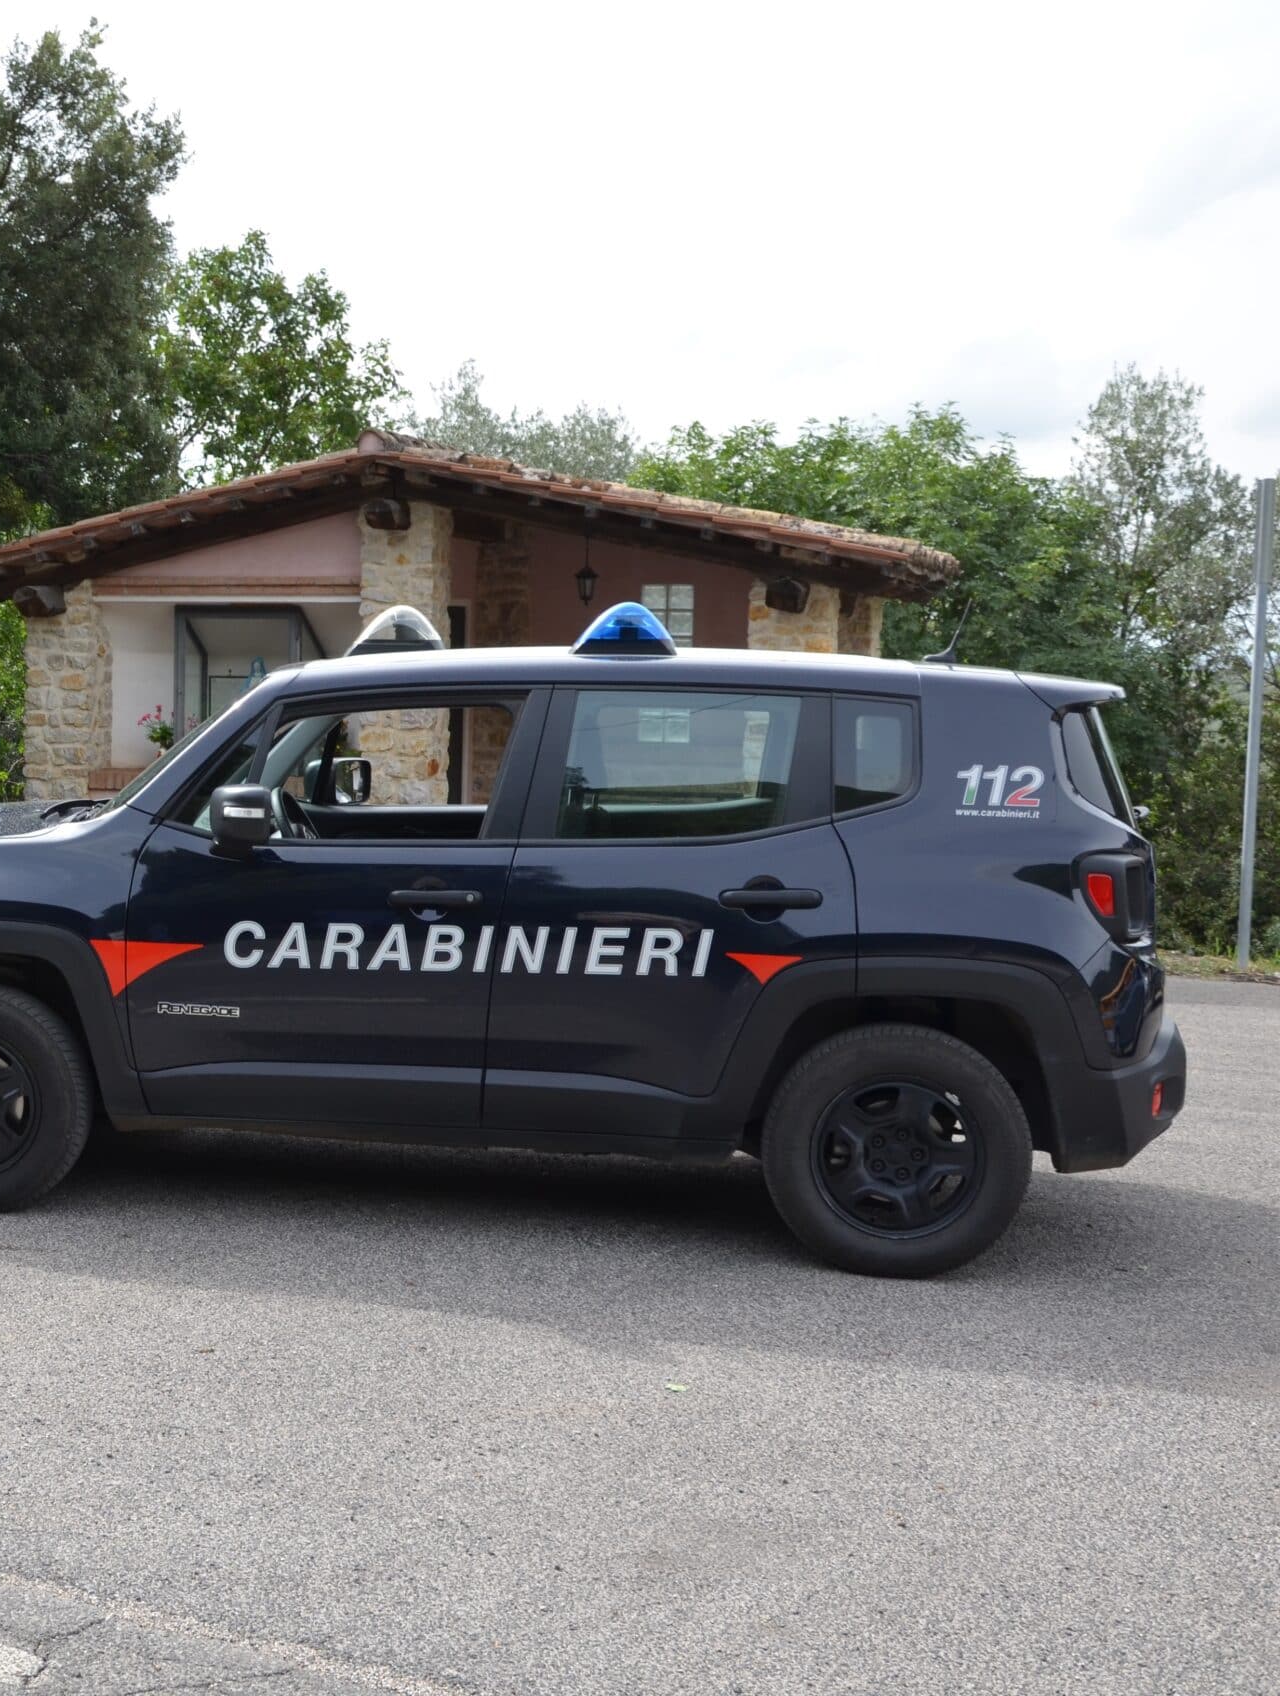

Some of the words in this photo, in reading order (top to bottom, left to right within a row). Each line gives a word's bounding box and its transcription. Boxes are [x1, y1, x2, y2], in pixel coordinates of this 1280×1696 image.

[956, 764, 1045, 807] 112
[955, 808, 1040, 819] www.carabinieri.it
[223, 920, 714, 977] CARABINIERI
[157, 1002, 240, 1018] RENEGADE
